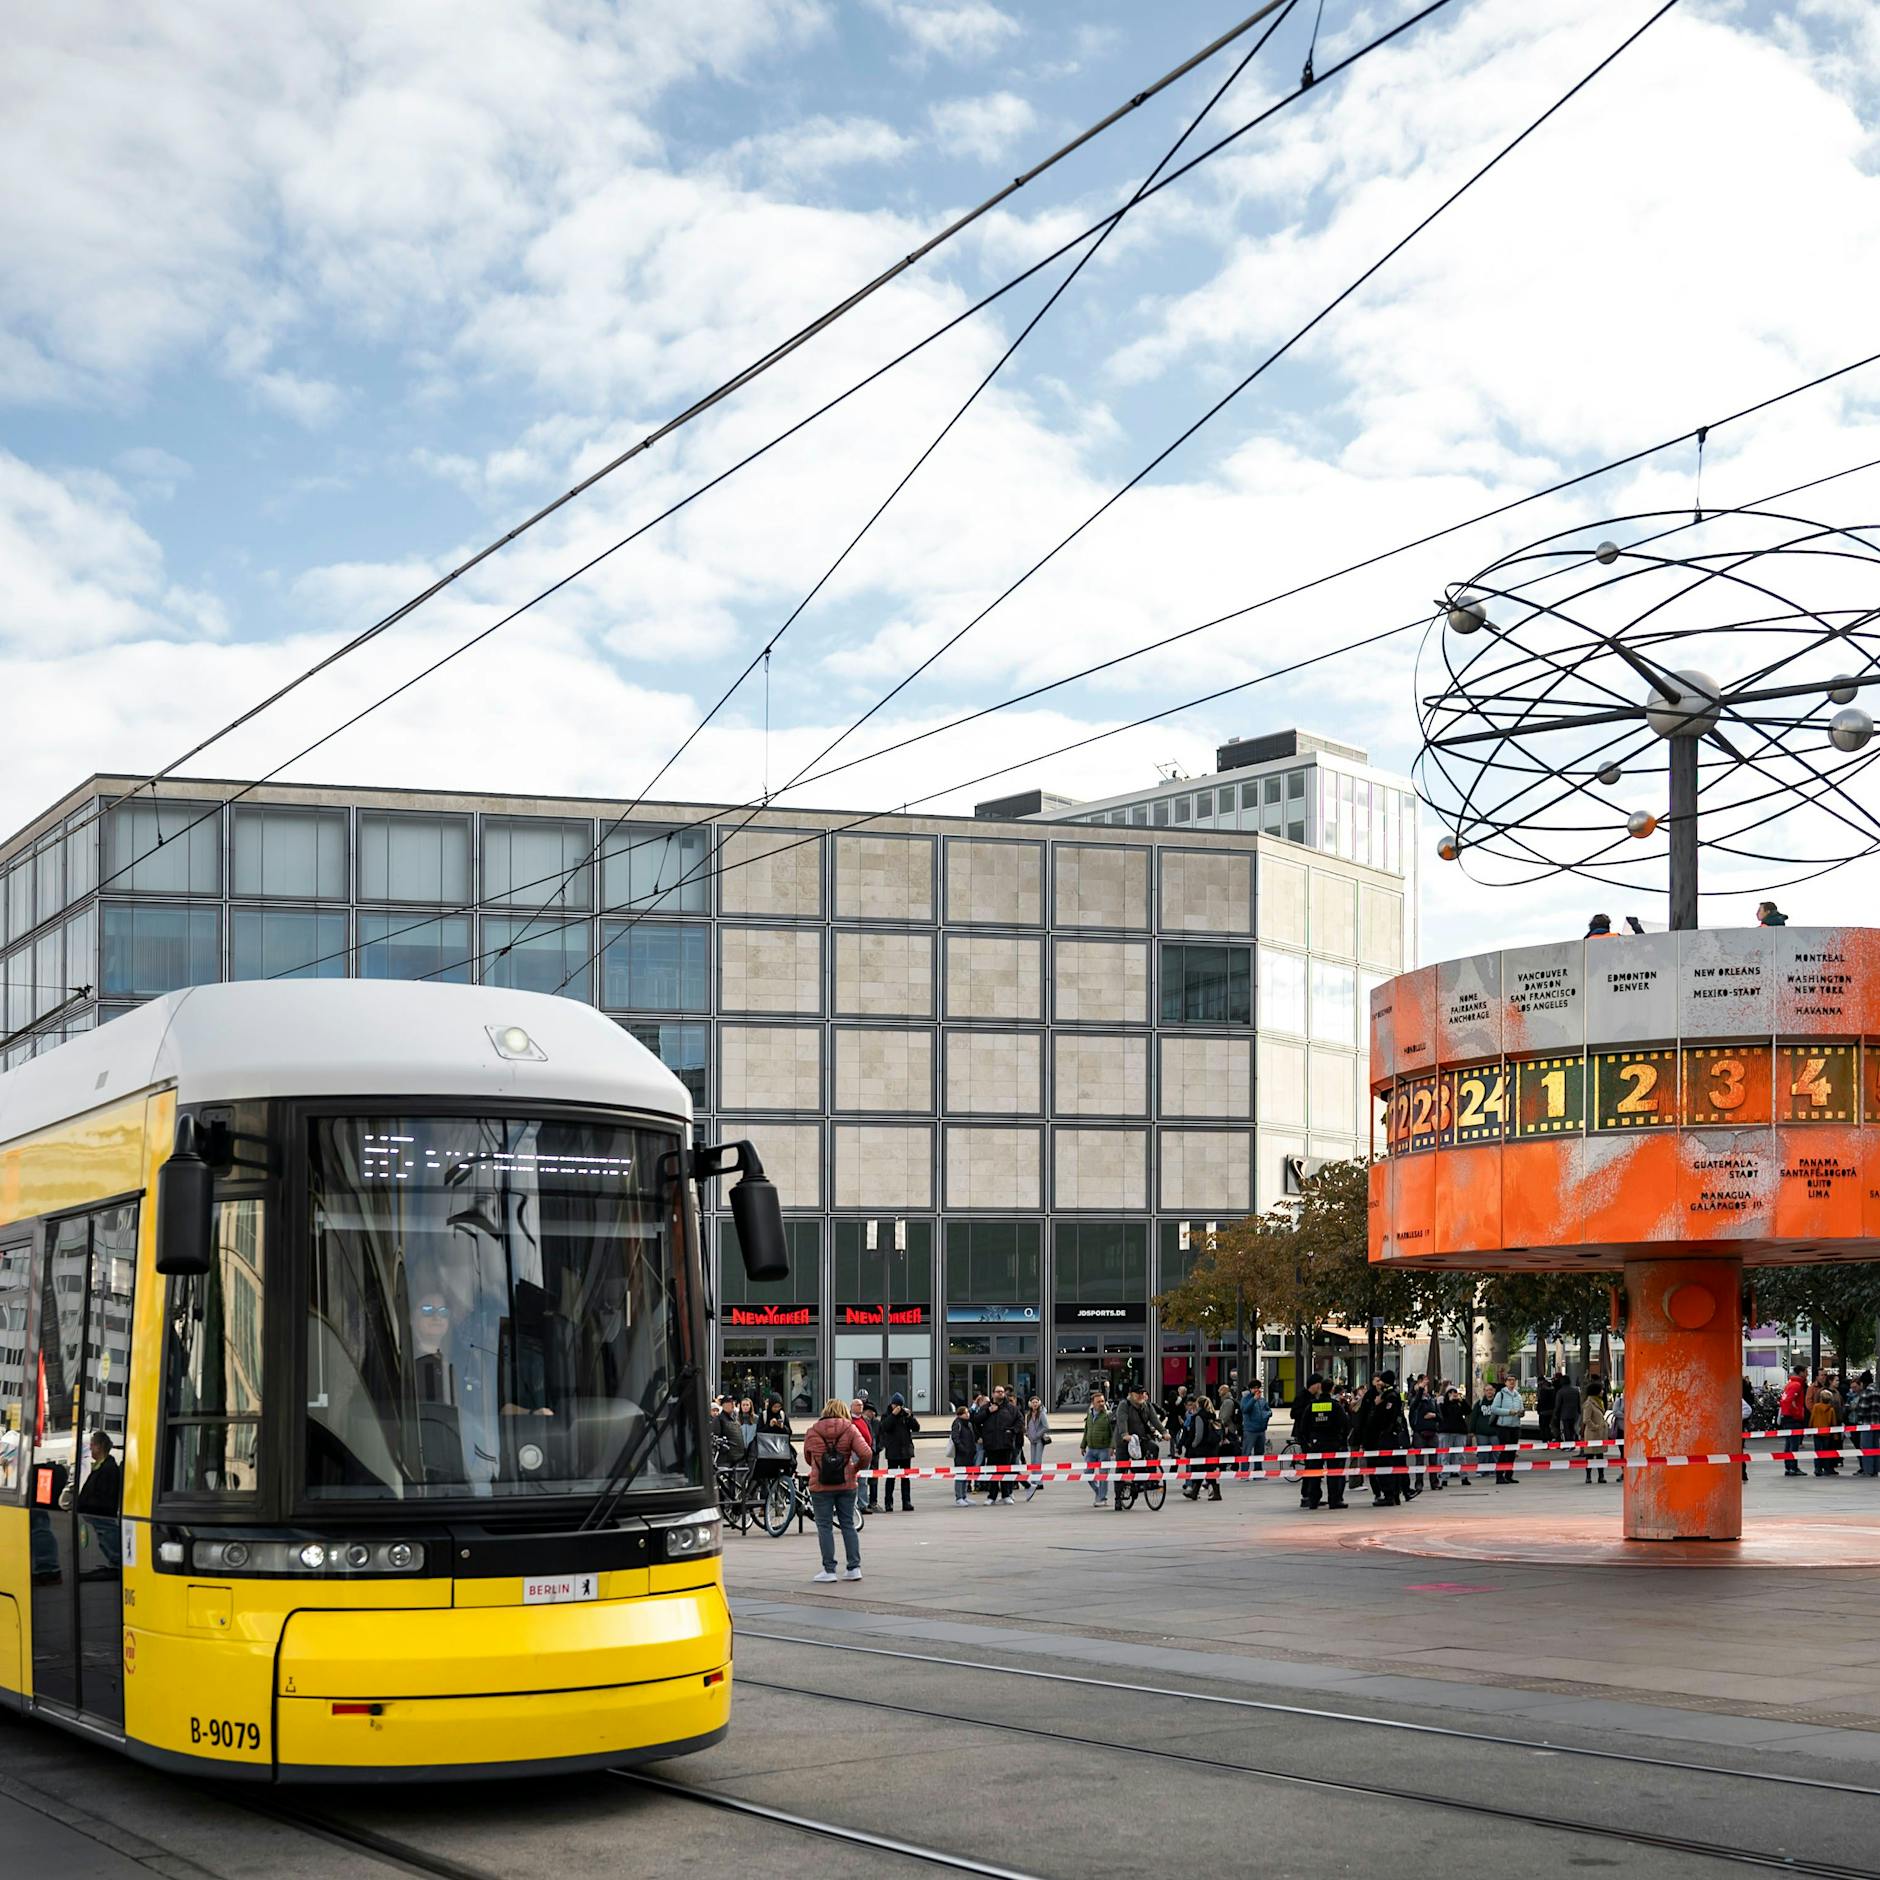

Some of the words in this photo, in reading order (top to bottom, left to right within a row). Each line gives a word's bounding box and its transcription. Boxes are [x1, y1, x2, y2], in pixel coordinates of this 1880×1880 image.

[1795, 954, 1845, 962] MONTREAL
[1518, 968, 1568, 982] VANCOUVER
[1694, 968, 1715, 977] NEW
[1718, 966, 1761, 976] ORLEANS
[1607, 971, 1657, 983] EDMONTON
[1787, 975, 1852, 983] WASHINGTON
[1524, 980, 1561, 991] DAWSON
[1613, 982, 1650, 992] DENVER
[1795, 986, 1816, 994] NEW
[1821, 986, 1844, 994] YORK
[1459, 993, 1478, 1003] NOME
[1510, 994, 1526, 1003] SAN
[1529, 988, 1576, 1001] FRANCISCO
[1693, 987, 1761, 999] MEXIKO-STADT
[1451, 1001, 1487, 1015] FAIRBANKS
[1517, 1003, 1531, 1013] LOS
[1533, 999, 1568, 1011] ANGELES
[1795, 1007, 1843, 1015] HAVANNA
[1448, 1011, 1490, 1025] ANCHORAGE
[1413, 1084, 1451, 1135] 23
[1458, 1075, 1511, 1128] 24
[1541, 1070, 1566, 1118] 1
[1617, 1063, 1659, 1114] 2
[1708, 1060, 1746, 1110] 3
[1791, 1058, 1832, 1107] 4
[1799, 1158, 1839, 1167] PANAMA
[1729, 1170, 1759, 1179] STADT
[1807, 1179, 1832, 1188] QUITO
[1701, 1191, 1751, 1200] MANAGUA
[1808, 1190, 1830, 1199] LIMA
[1077, 1309, 1127, 1317] JDSPORTS.DE
[528, 1583, 570, 1596] BERLIN
[191, 1716, 261, 1750] B-9079
